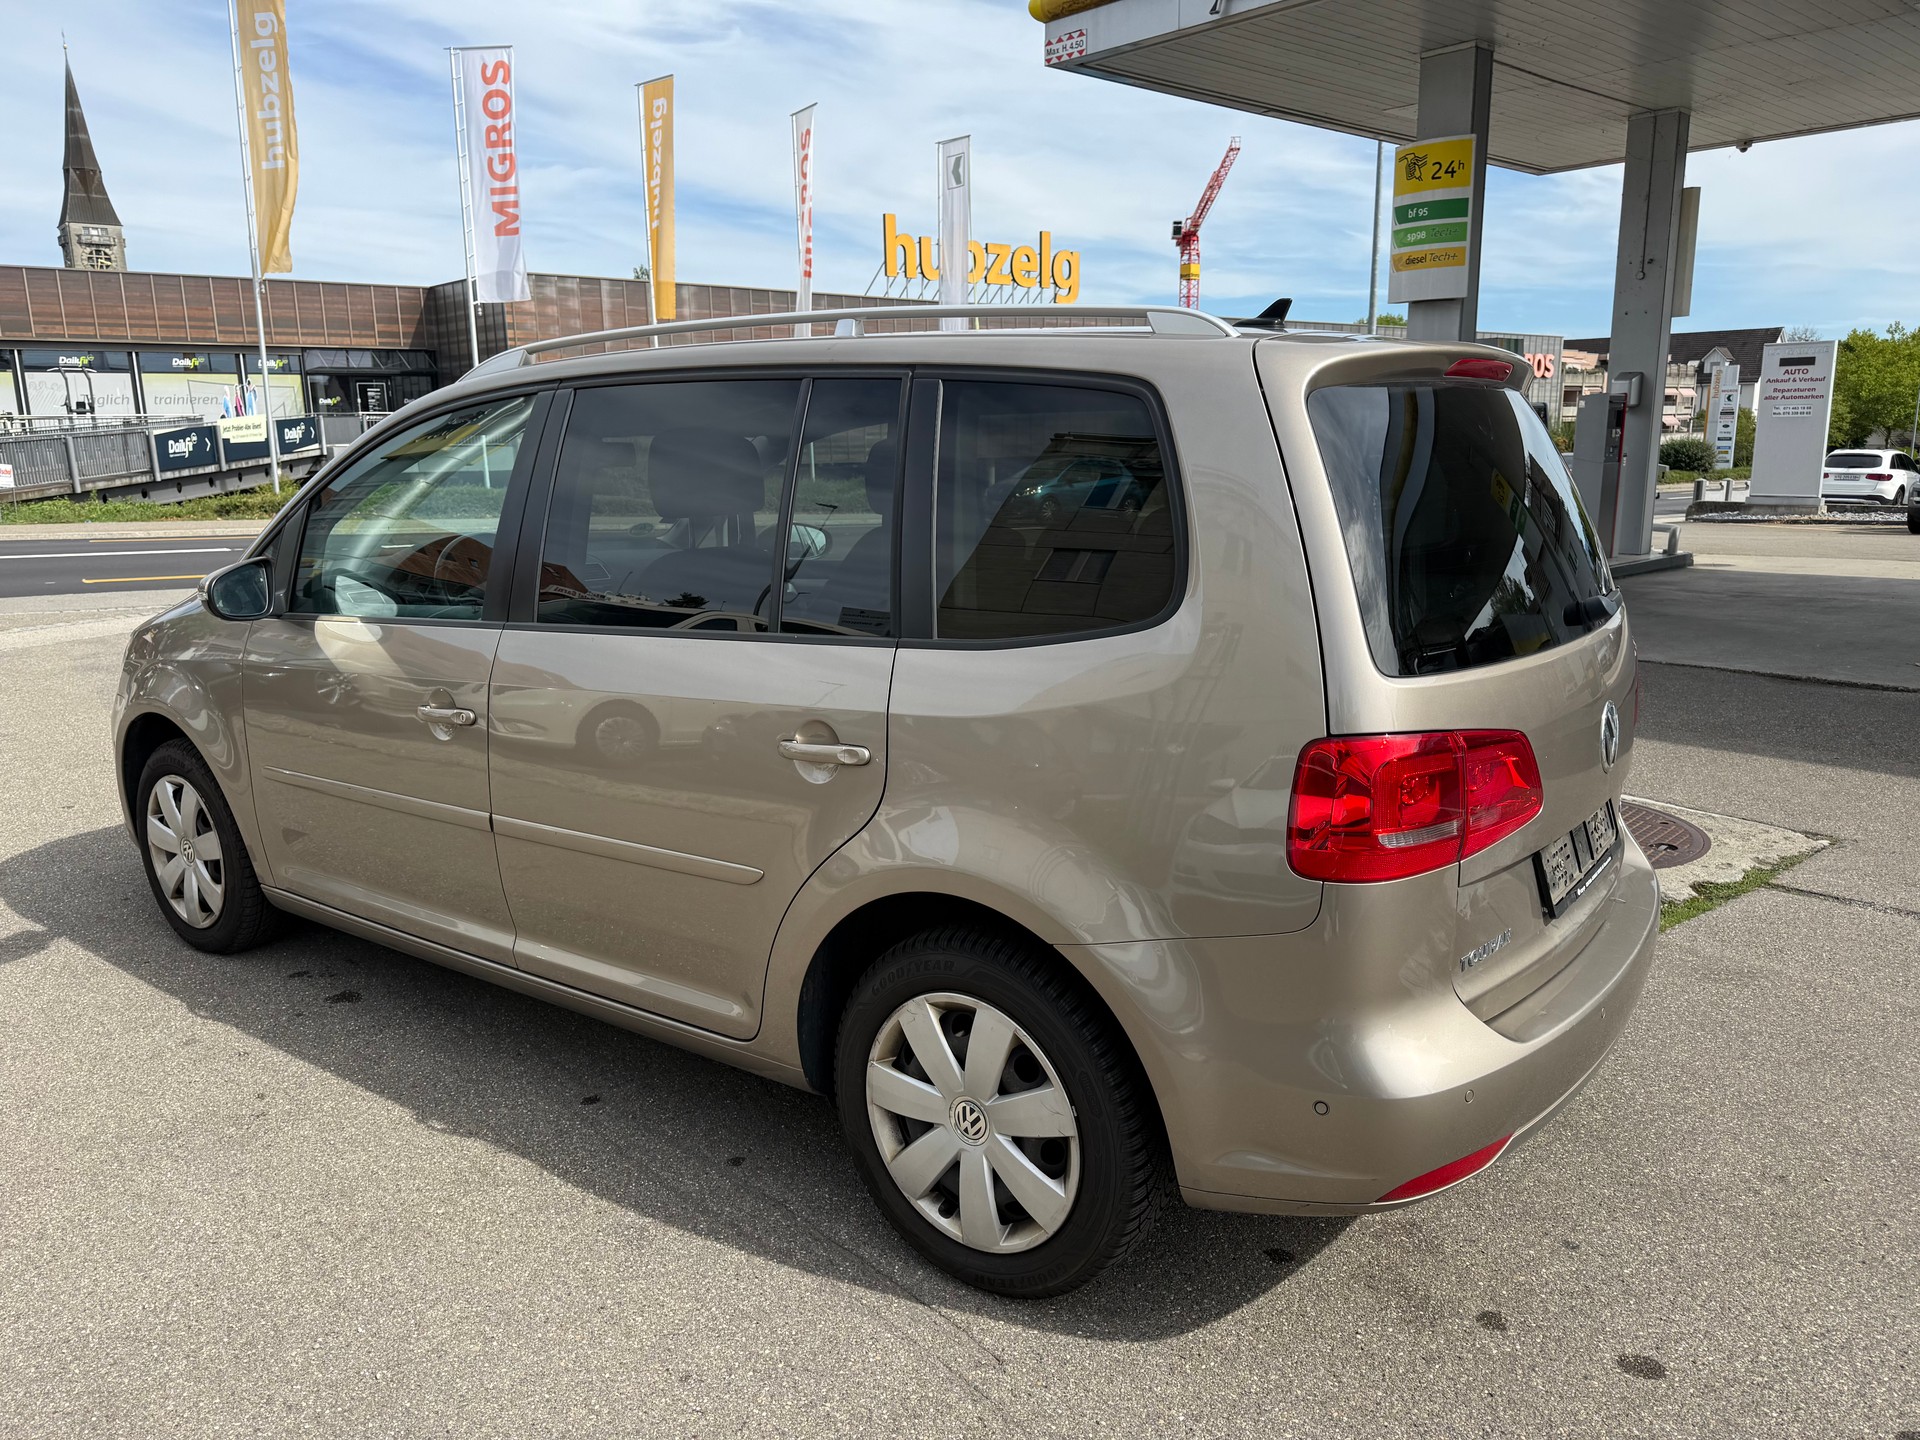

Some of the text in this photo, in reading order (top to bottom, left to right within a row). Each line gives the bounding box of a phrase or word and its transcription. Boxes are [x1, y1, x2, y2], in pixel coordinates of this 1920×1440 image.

[1046, 47, 1060, 56] Max
[1069, 39, 1084, 50] 4.50
[250, 12, 285, 170] hubzelg
[480, 58, 520, 237] MIGROS
[1408, 207, 1428, 218] bf 95
[1406, 228, 1459, 242] sp98 Tech+
[1405, 252, 1458, 265] diesel Tech+
[1799, 375, 1826, 383] Verkauf
[80, 394, 130, 408] Tglich
